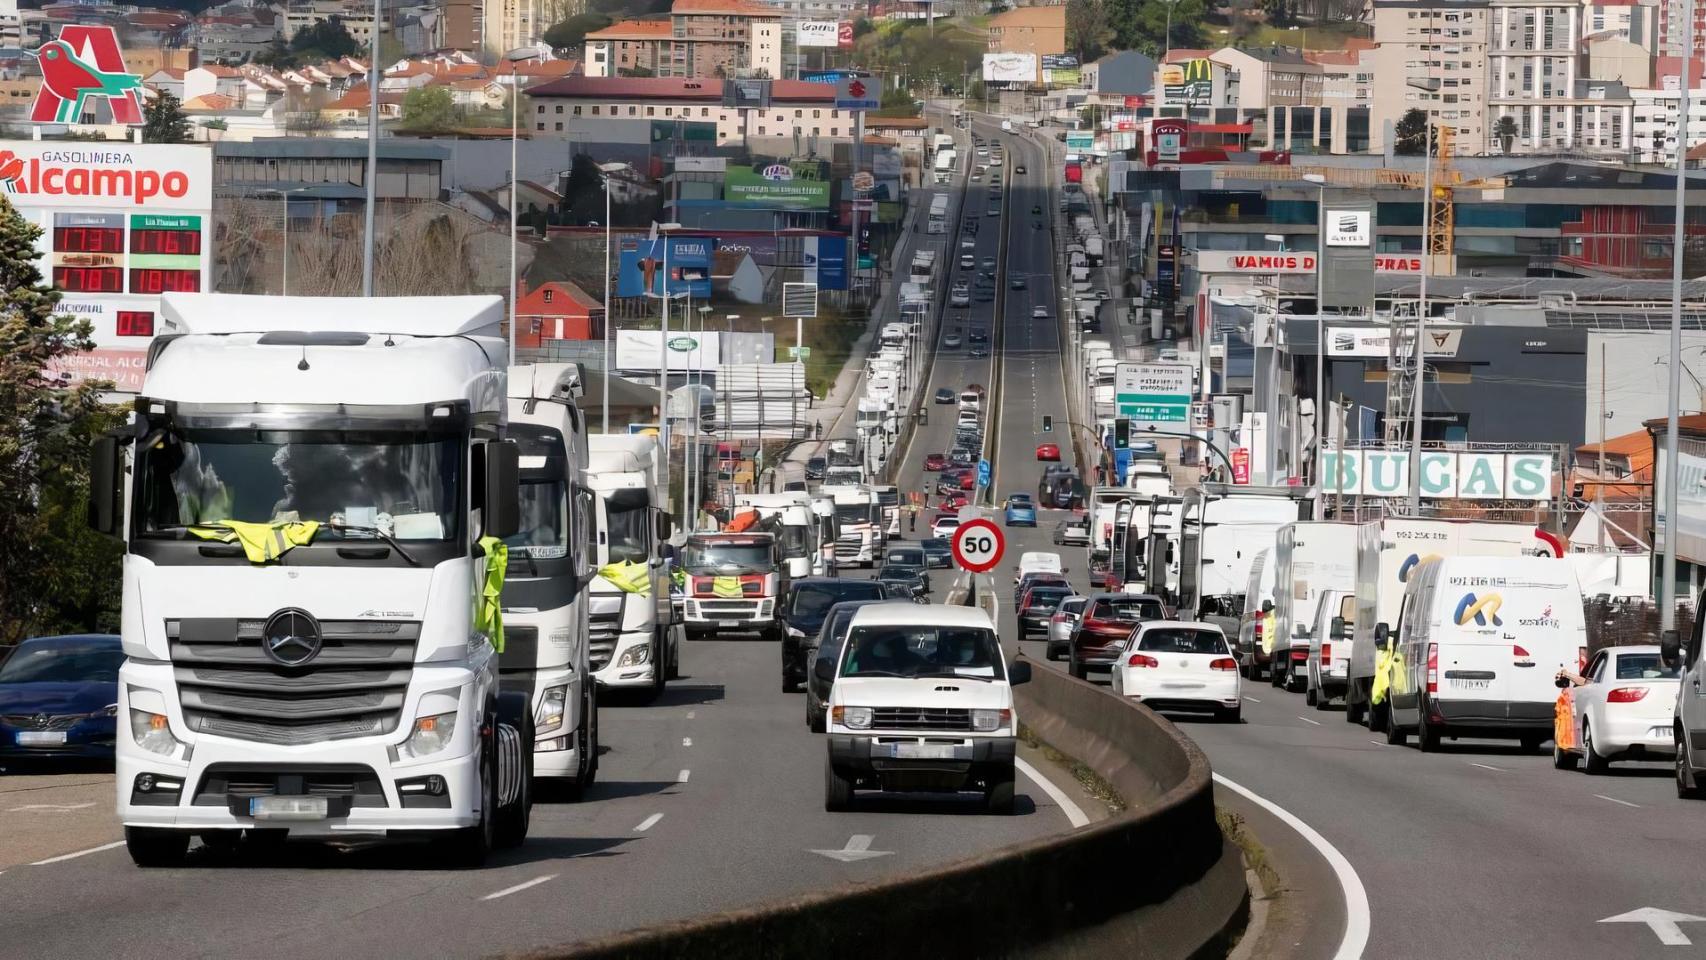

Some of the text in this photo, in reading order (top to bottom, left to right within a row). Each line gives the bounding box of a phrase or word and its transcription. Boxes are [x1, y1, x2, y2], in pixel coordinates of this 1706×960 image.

[42, 151, 133, 164] GASOLINERA
[1235, 256, 1297, 269] VAMOS
[1323, 453, 1547, 496] BUGAS
[964, 537, 992, 554] 50
